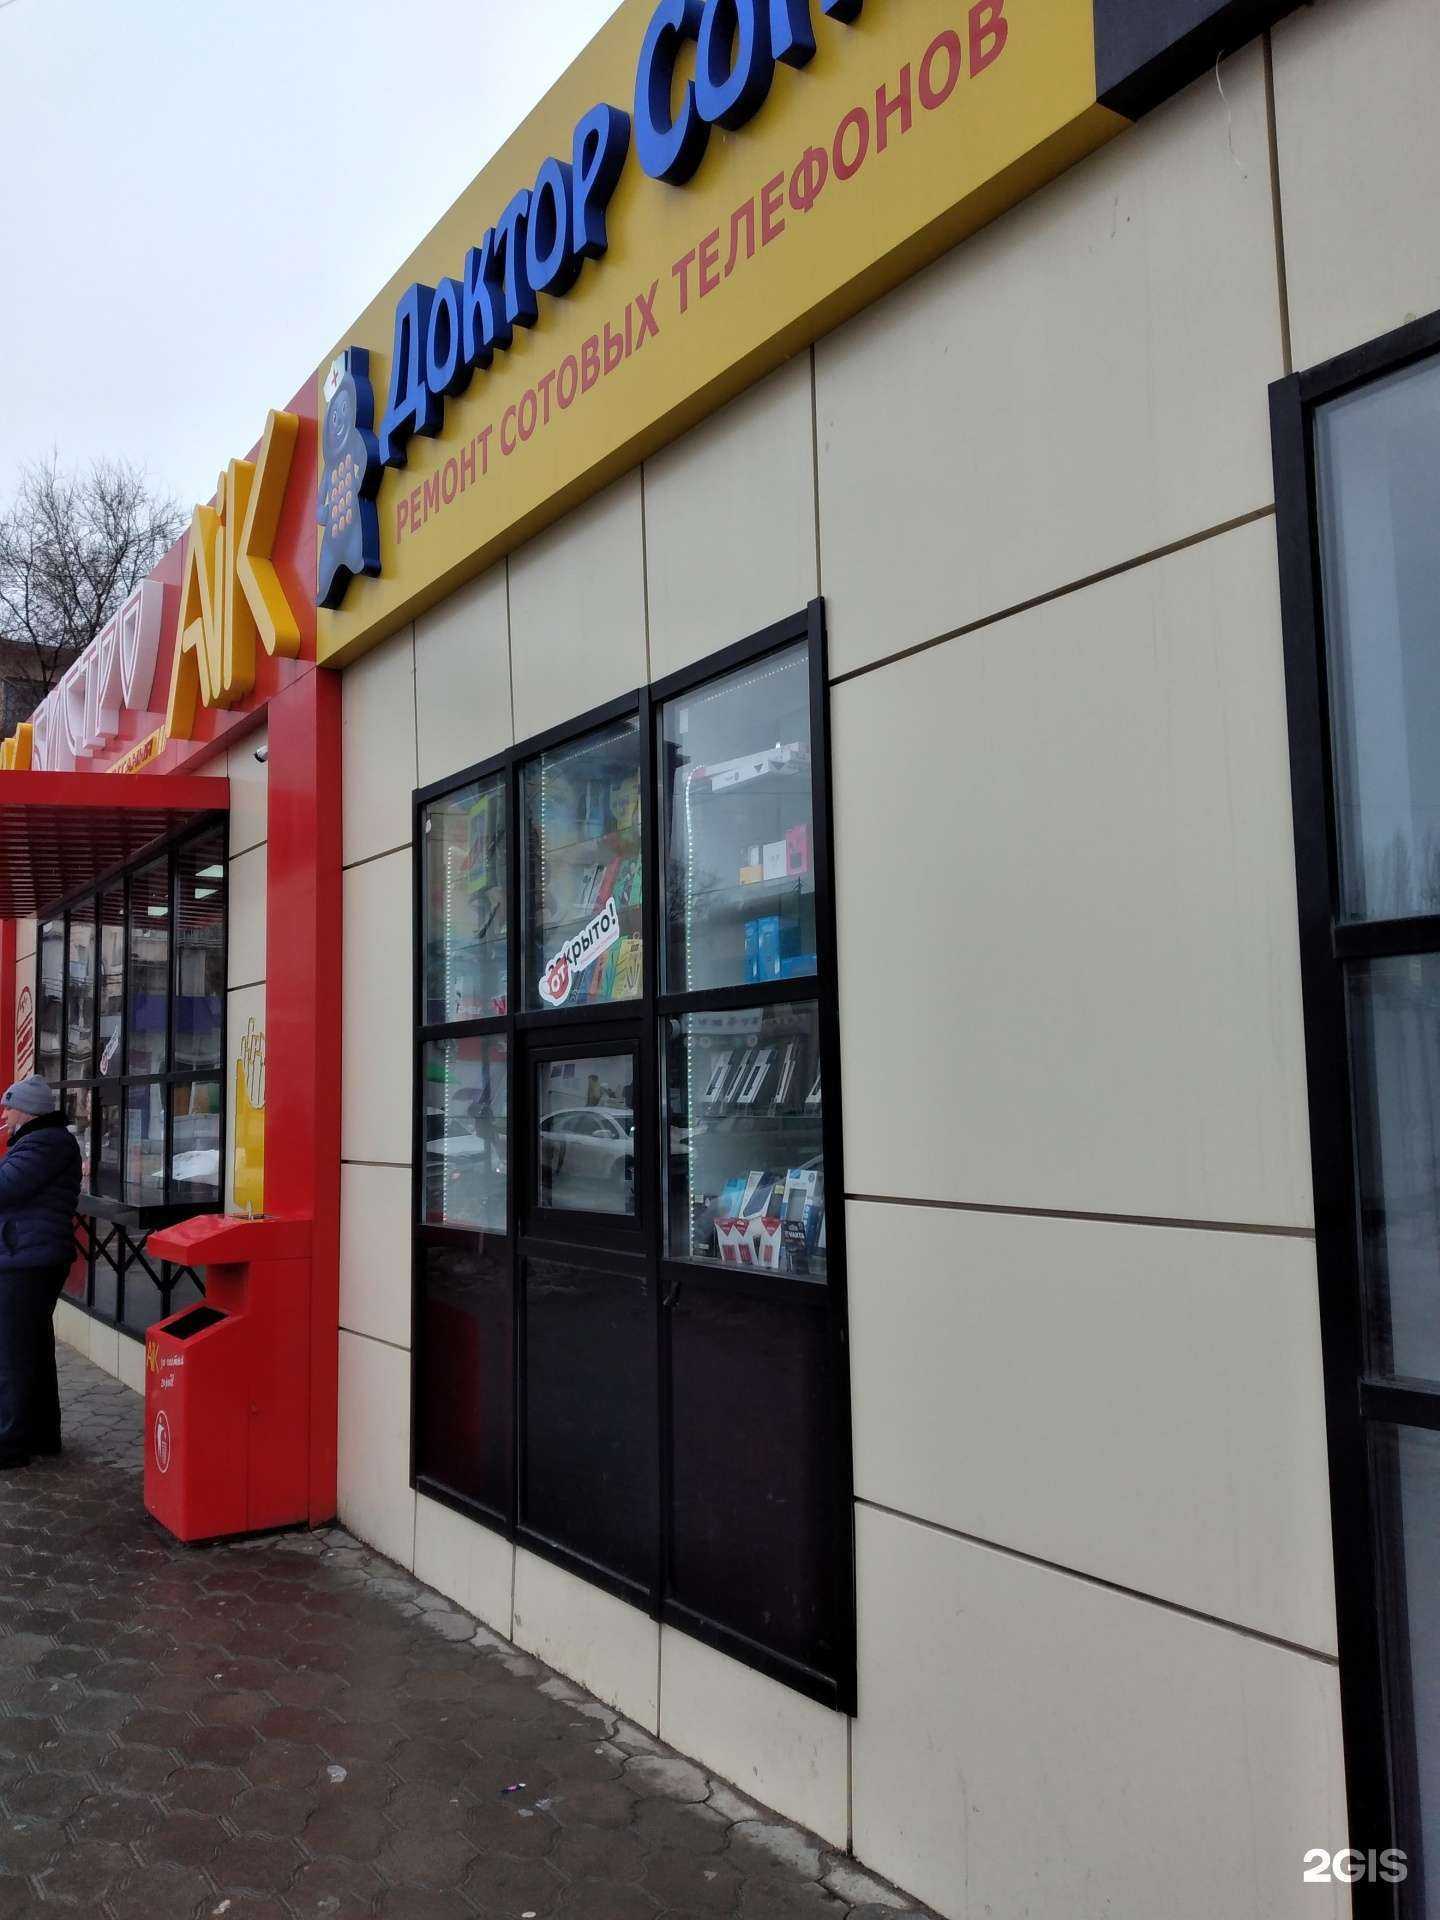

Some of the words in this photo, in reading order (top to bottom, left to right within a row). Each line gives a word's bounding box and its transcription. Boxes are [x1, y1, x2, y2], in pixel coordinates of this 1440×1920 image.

[380, 102, 630, 467] ДОКТОР
[634, 0, 862, 186] СО
[394, 423, 493, 545] РЕМОНТ
[500, 278, 661, 456] СОТОВЫХ
[671, 0, 1009, 315] ТЕЛЕФОНОВ
